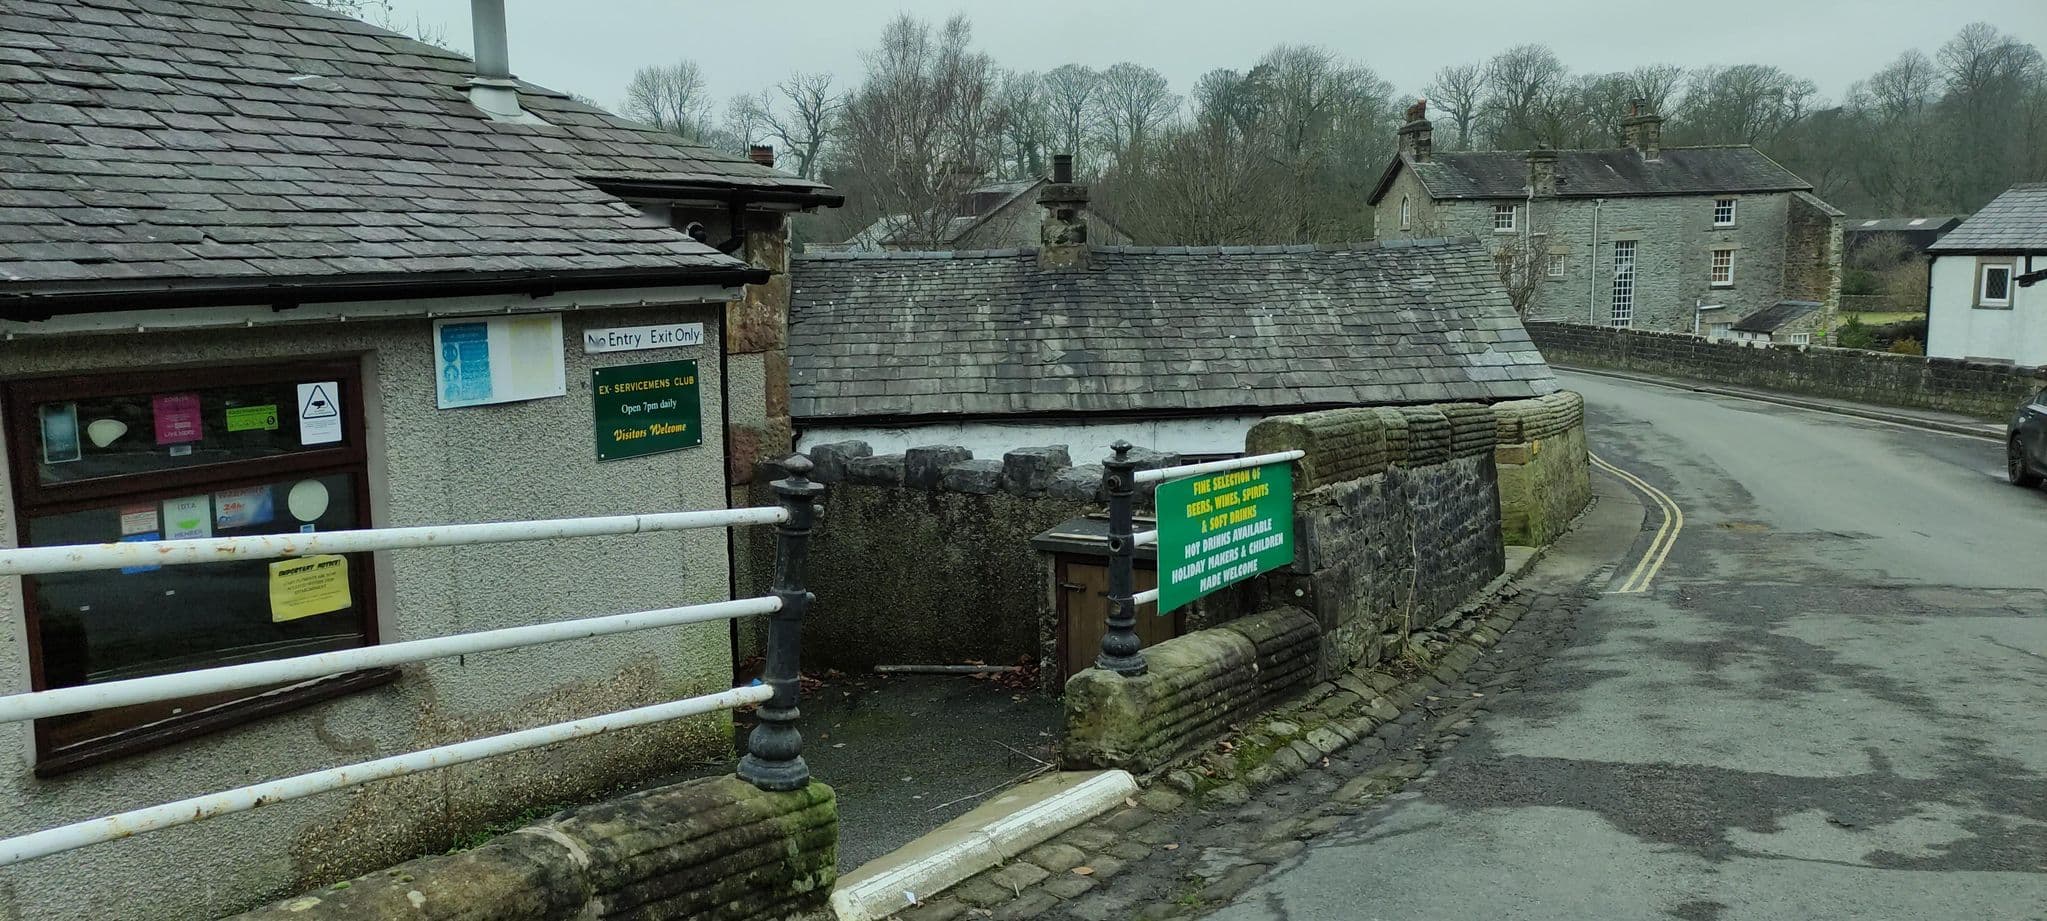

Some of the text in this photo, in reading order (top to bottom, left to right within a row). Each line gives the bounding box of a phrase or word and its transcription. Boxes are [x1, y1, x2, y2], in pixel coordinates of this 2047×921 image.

[608, 332, 642, 348] Entry
[650, 329, 673, 344] Exit
[675, 328, 701, 344] Only
[614, 379, 670, 393] SERVICEMENS
[674, 376, 695, 387] CLUB
[621, 399, 677, 415] Open 7pm daily
[614, 422, 687, 441] Visitors Welcome
[1193, 467, 1261, 496] FINE SELECTION OF
[1186, 484, 1269, 518] BEERS, WINES, SPIRITS
[1202, 505, 1257, 533] & SOFT DRINKS
[1185, 518, 1272, 558] HOT DRINKS AVAILABLE
[1172, 533, 1284, 584] HOLIDAY MAKERS & CHILDREN
[1200, 559, 1258, 592] MADE WELCOME
